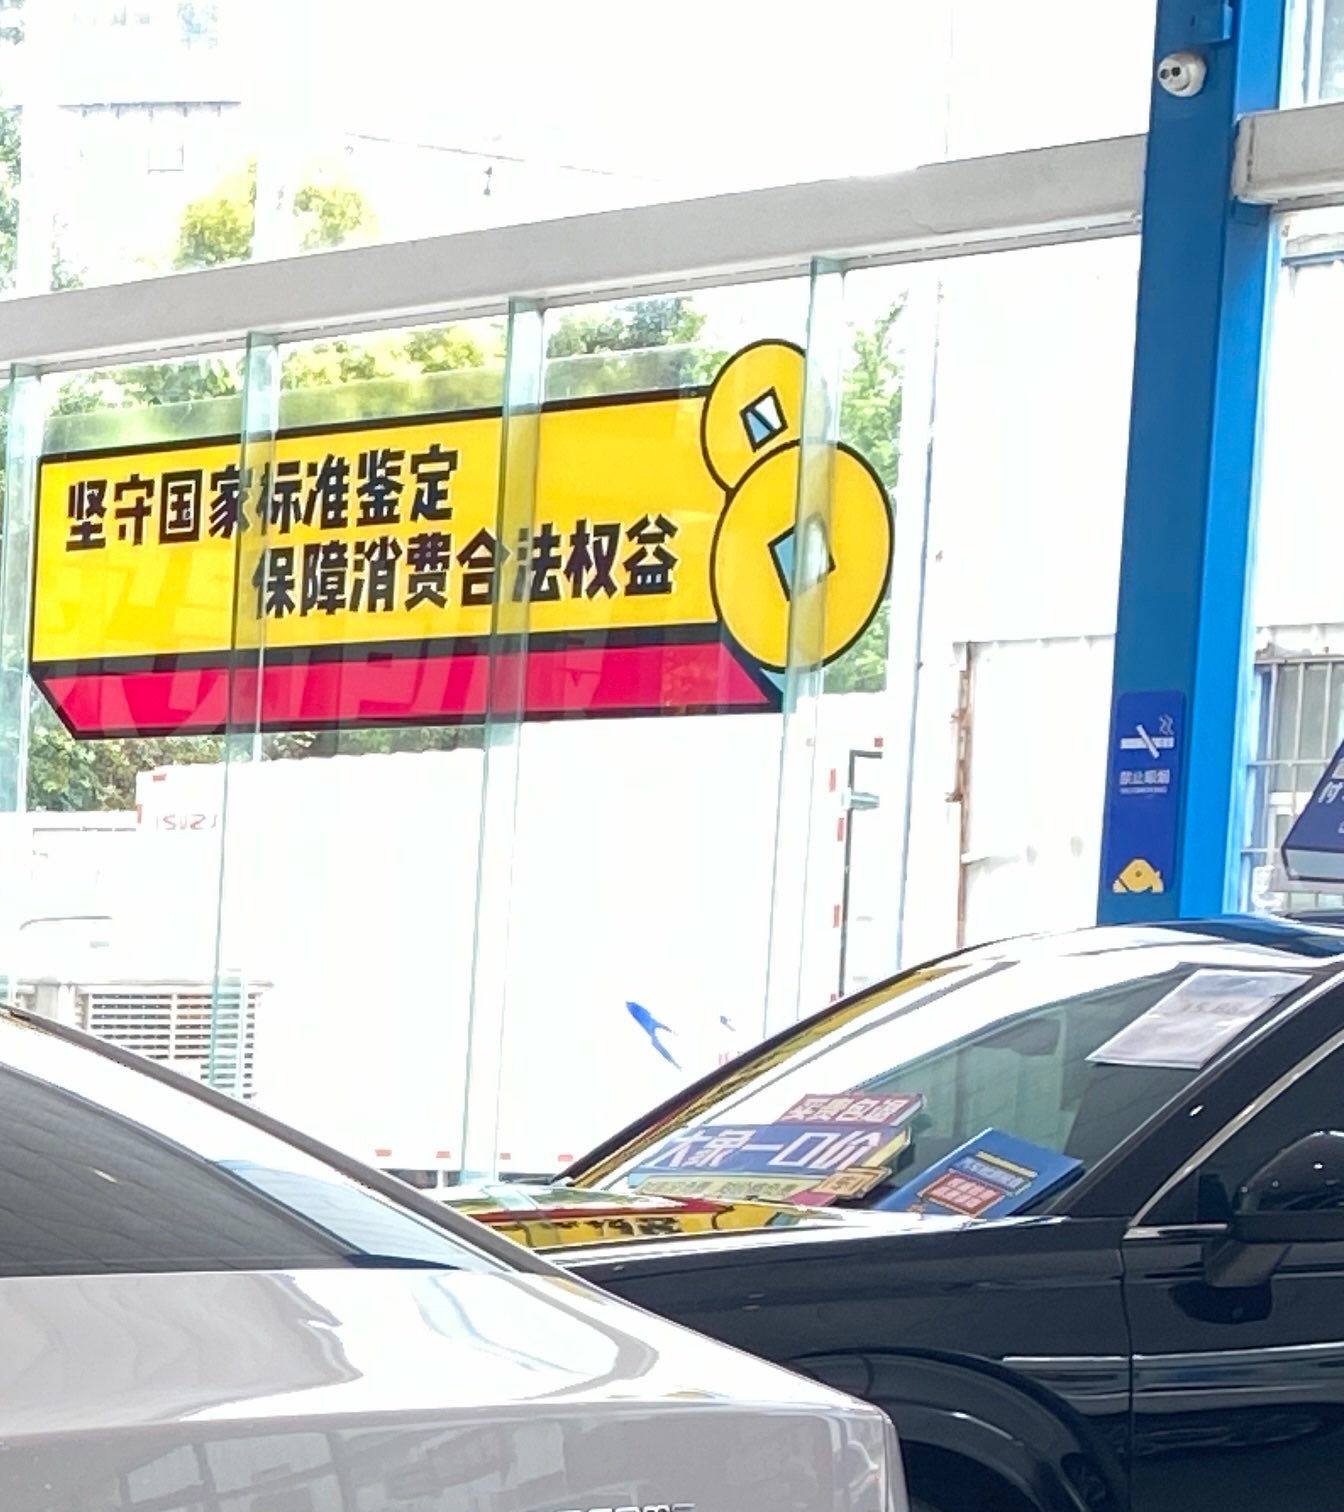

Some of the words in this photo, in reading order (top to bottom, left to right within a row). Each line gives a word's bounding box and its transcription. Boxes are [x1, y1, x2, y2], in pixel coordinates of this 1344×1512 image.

[65, 444, 461, 553] 坚守国家标准鉴定
[253, 511, 680, 620] 保障消费合法权益
[640, 1128, 883, 1169] 大象一口价
